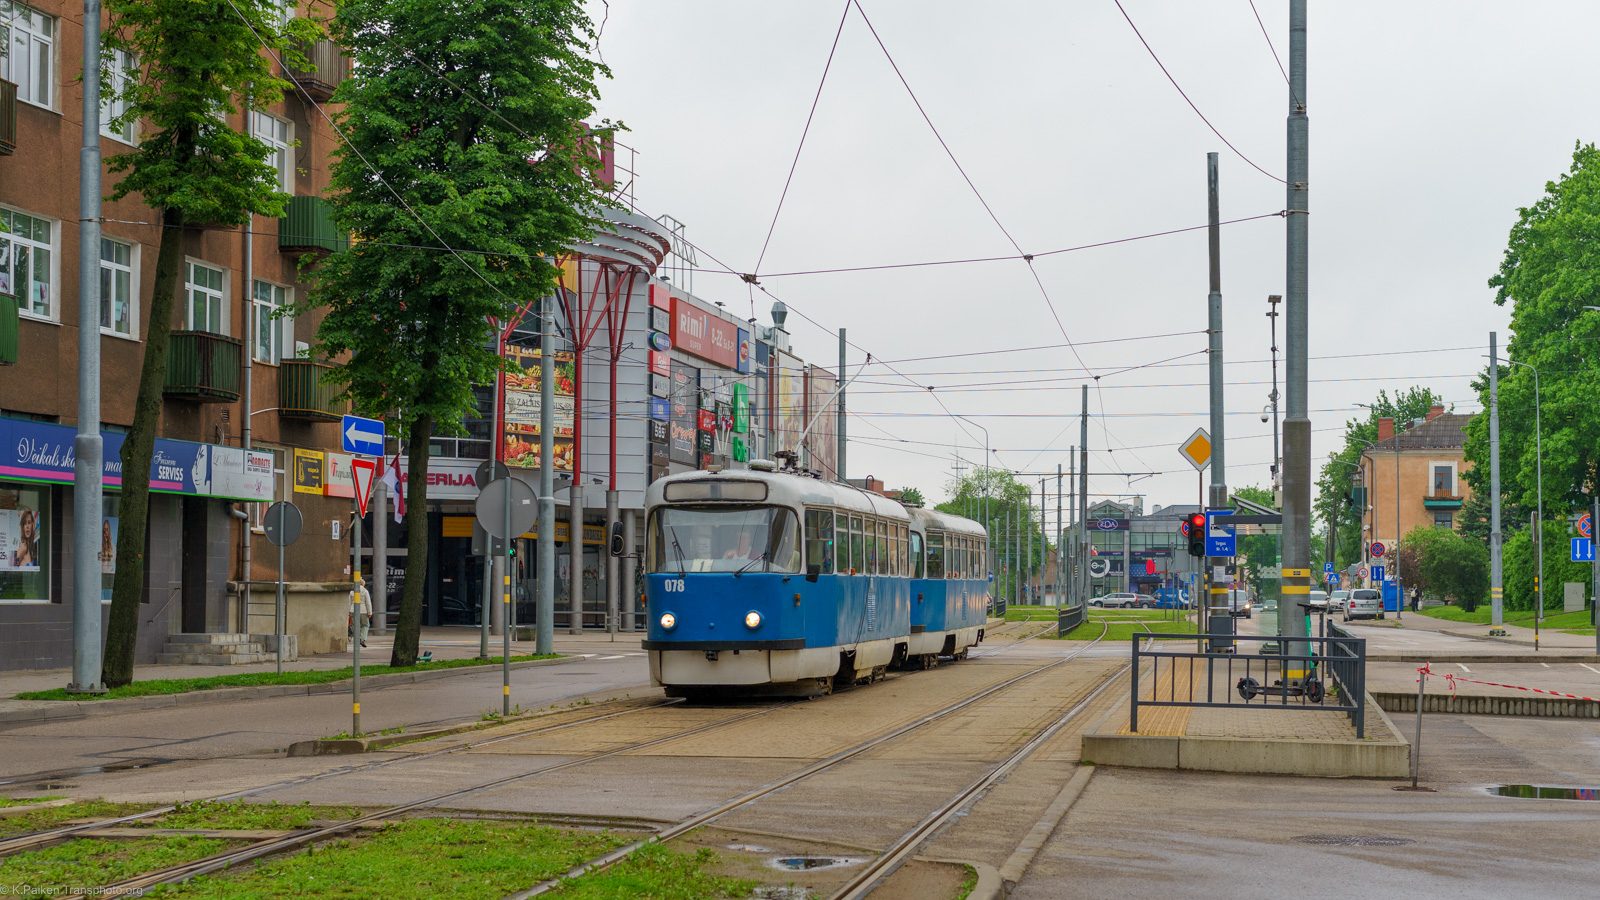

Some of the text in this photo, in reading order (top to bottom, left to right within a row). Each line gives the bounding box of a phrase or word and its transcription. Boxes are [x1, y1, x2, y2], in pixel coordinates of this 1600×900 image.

[680, 311, 703, 341] Rimi
[689, 339, 702, 352] SUPER
[711, 327, 723, 348] 8-22
[17, 437, 59, 466] Veikals
[60, 446, 76, 468] ska
[158, 465, 184, 482] SERVISS
[400, 472, 477, 487] AERIJA
[1326, 563, 1331, 571] P
[664, 579, 685, 592] 078
